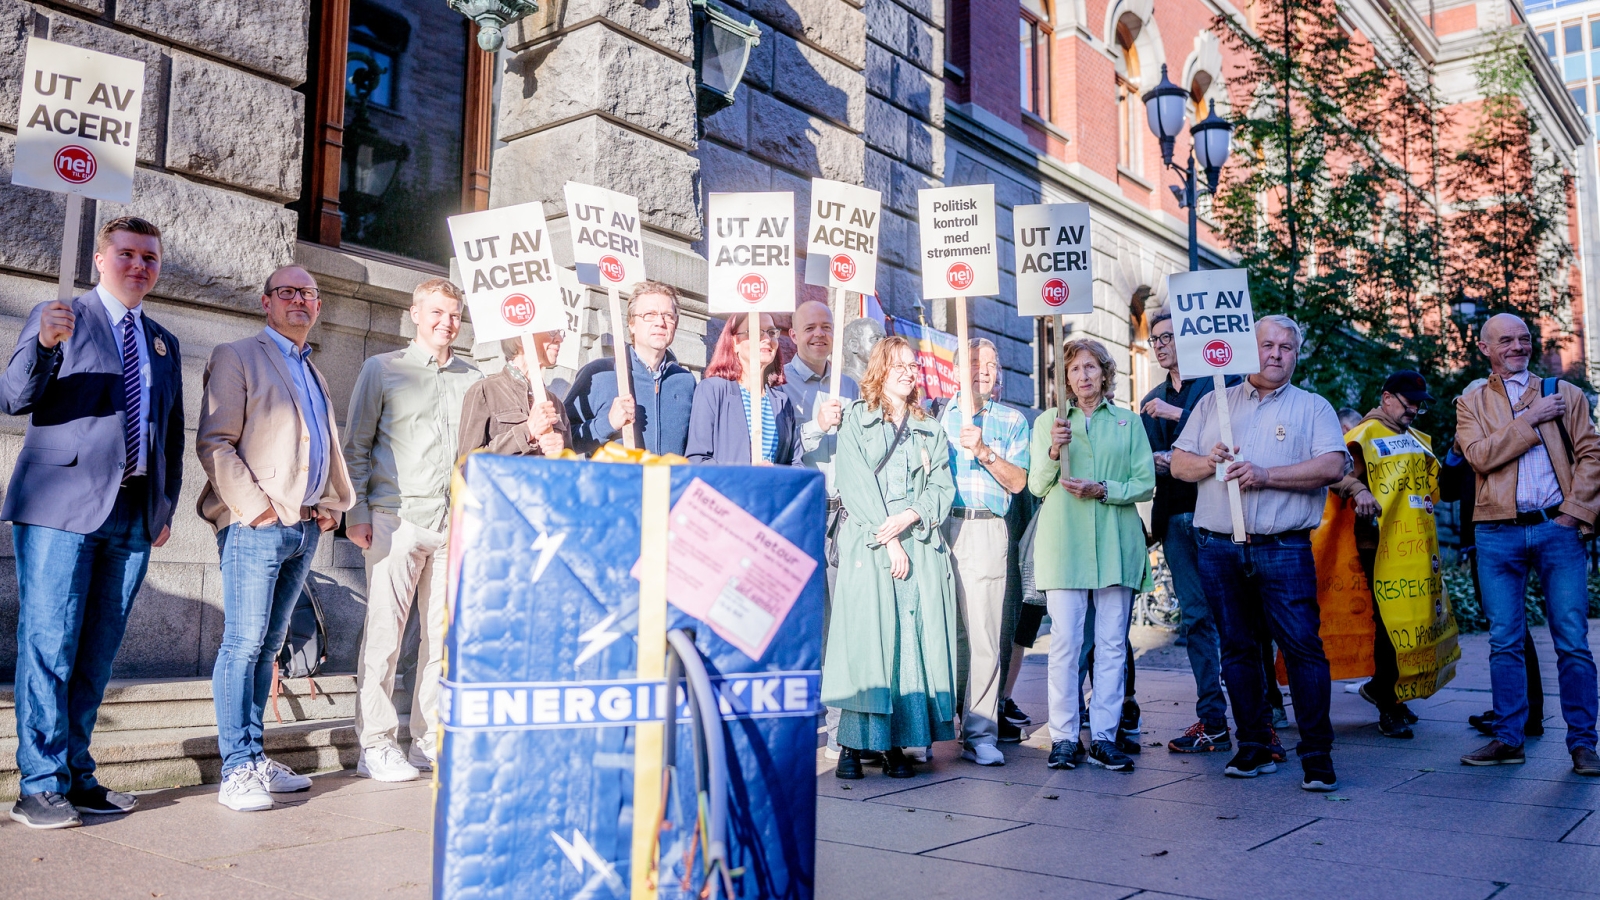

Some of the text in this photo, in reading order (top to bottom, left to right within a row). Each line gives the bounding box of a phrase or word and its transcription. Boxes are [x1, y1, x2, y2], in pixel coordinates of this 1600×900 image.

[34, 70, 135, 112] UT AV
[26, 103, 132, 147] ACER!
[59, 155, 92, 174] nei
[817, 200, 876, 229] UT AV
[933, 198, 977, 213] Politisk
[575, 203, 636, 233] UT AV
[717, 217, 789, 238] UT AV
[933, 214, 978, 229] kontroll
[463, 229, 542, 262] UT AV
[577, 226, 640, 258] ACER!
[813, 224, 874, 255] ACER!
[944, 231, 969, 244] med
[1021, 225, 1085, 247] UT AV
[715, 244, 790, 266] ACER!
[927, 243, 991, 259] strømmen!
[1021, 250, 1088, 274] ACER!
[472, 258, 552, 294] ACER!
[602, 261, 622, 275] nei
[833, 260, 853, 274] nei
[949, 266, 970, 282] nei
[741, 279, 766, 294] nei
[1045, 282, 1065, 297] nei
[504, 298, 531, 318] nei
[1176, 290, 1244, 312] UT AV
[1180, 313, 1251, 337] ACER!
[1206, 344, 1229, 359] nei
[1379, 476, 1413, 495] OVER
[692, 487, 730, 518] Retur
[1393, 519, 1412, 535] TIL
[754, 531, 799, 565] Retour
[461, 677, 808, 726] ENERGIPKKE
